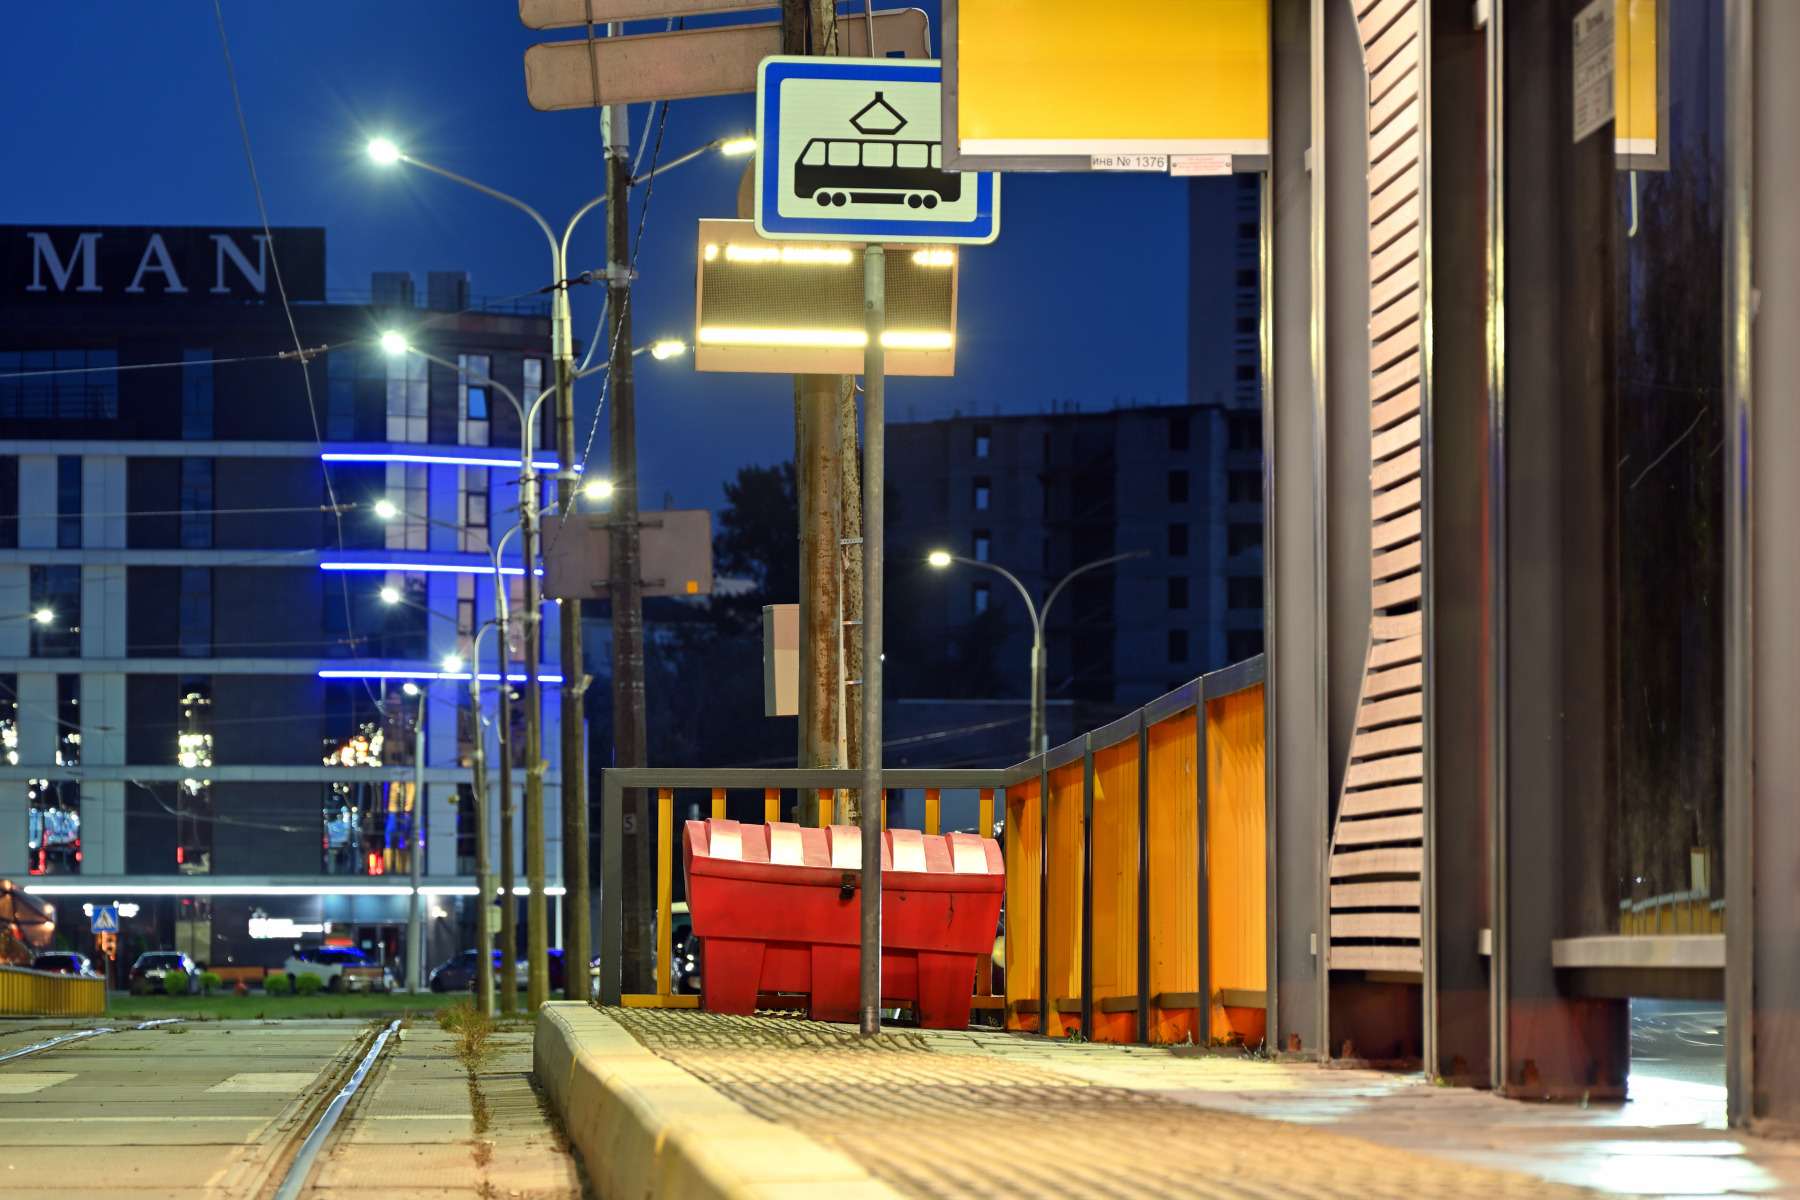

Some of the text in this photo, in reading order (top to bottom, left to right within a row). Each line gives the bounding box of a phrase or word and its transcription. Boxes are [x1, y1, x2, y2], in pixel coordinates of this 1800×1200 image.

[1117, 156, 1131, 166] №
[1135, 156, 1165, 168] 1376
[26, 233, 272, 292] MAN
